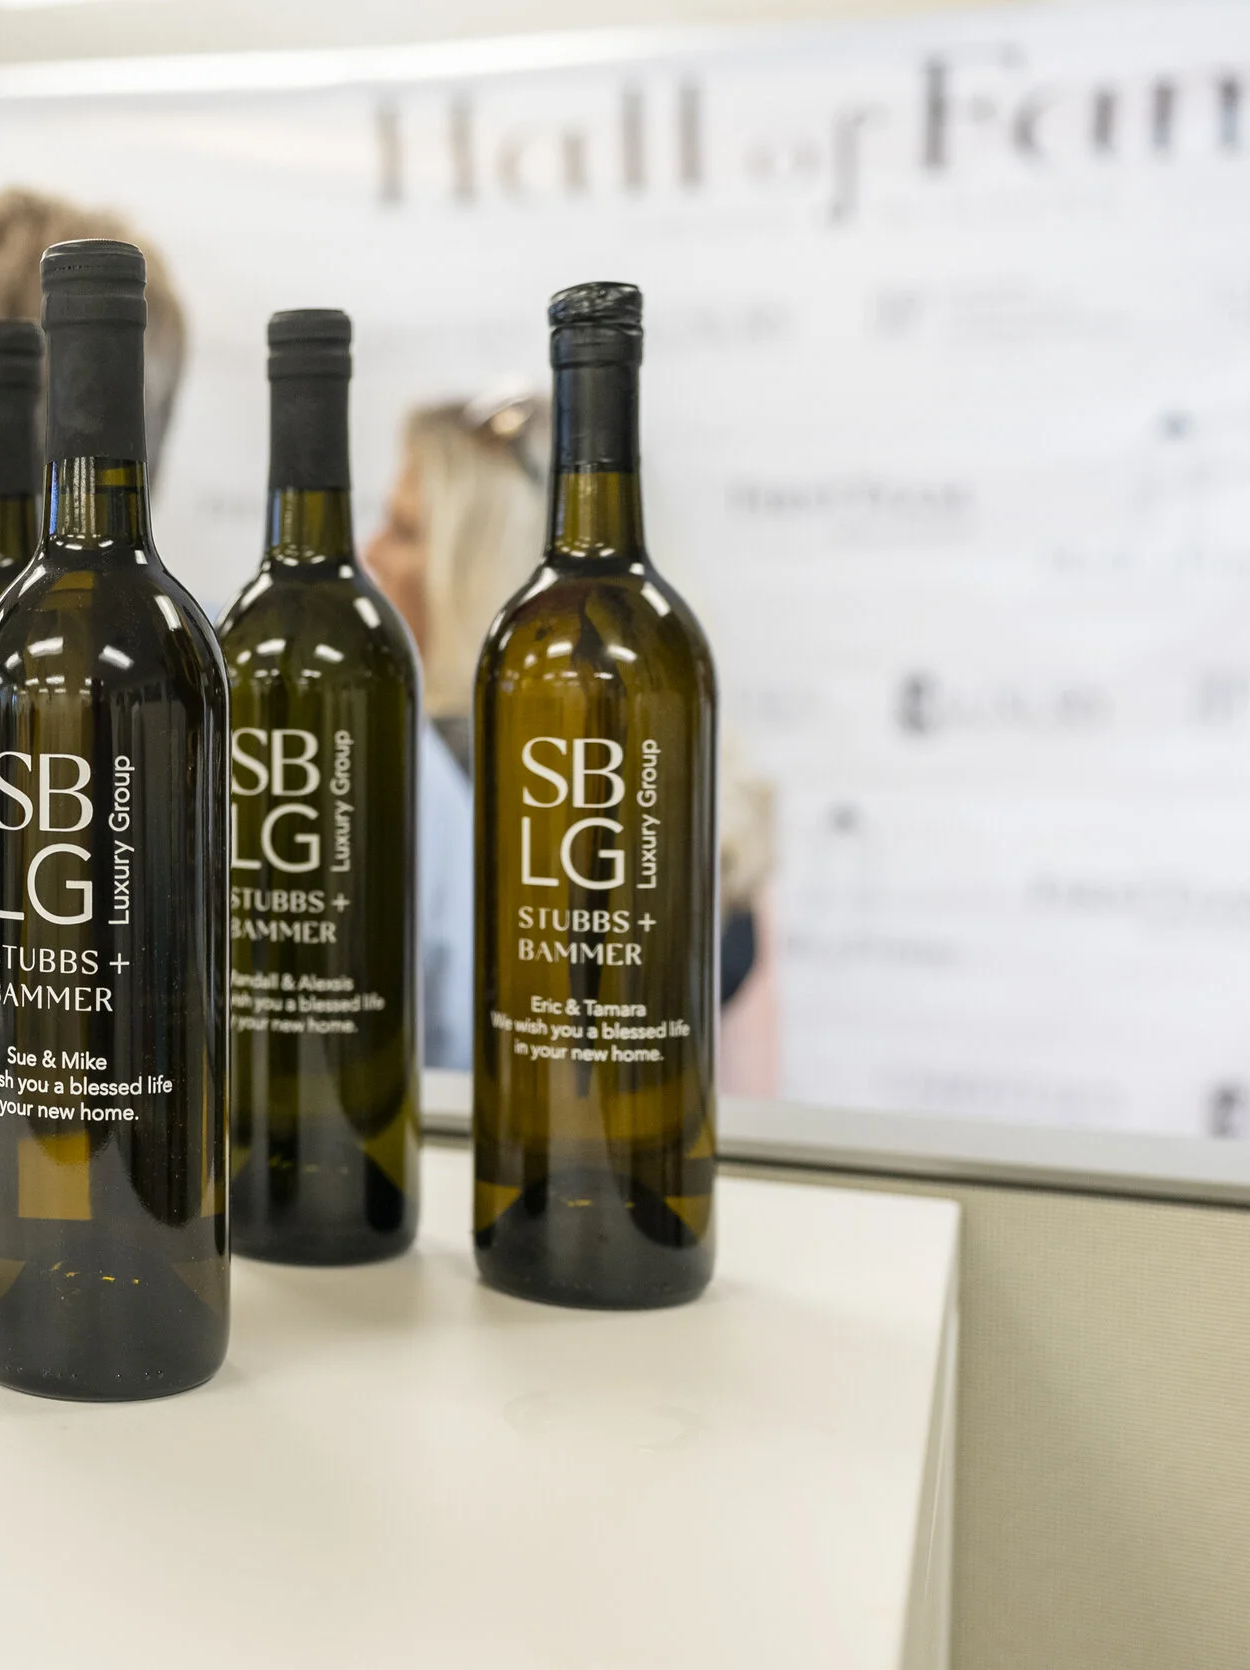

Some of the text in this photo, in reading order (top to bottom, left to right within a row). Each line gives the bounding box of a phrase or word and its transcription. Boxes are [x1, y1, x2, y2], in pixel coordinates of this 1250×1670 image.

[231, 727, 321, 796] SB
[522, 736, 625, 809] SB
[329, 729, 354, 872] Luxury Group
[637, 738, 661, 889] Luxury Group
[108, 755, 135, 925] Luxury Group
[231, 802, 320, 874] LG
[521, 816, 625, 890] LG
[231, 886, 325, 914] STUBBS
[231, 917, 337, 944] BAMMER
[518, 905, 630, 934] STUBBS
[518, 938, 642, 967] BAMMER
[252, 997, 283, 1013] you
[298, 994, 361, 1012] blessed
[530, 995, 647, 1018] Eric & Tamara
[270, 1018, 305, 1033] new
[490, 1010, 690, 1040] We wish you a blessed life
[7, 1046, 107, 1071] Sue & Mike
[514, 1038, 665, 1062] in your new home.
[17, 1078, 49, 1095] you
[54, 1081, 64, 1094] a
[69, 1076, 142, 1096] blessed
[148, 1074, 173, 1094] life
[0, 1100, 33, 1117] your
[37, 1104, 75, 1120] new
[80, 1102, 139, 1121] home.
